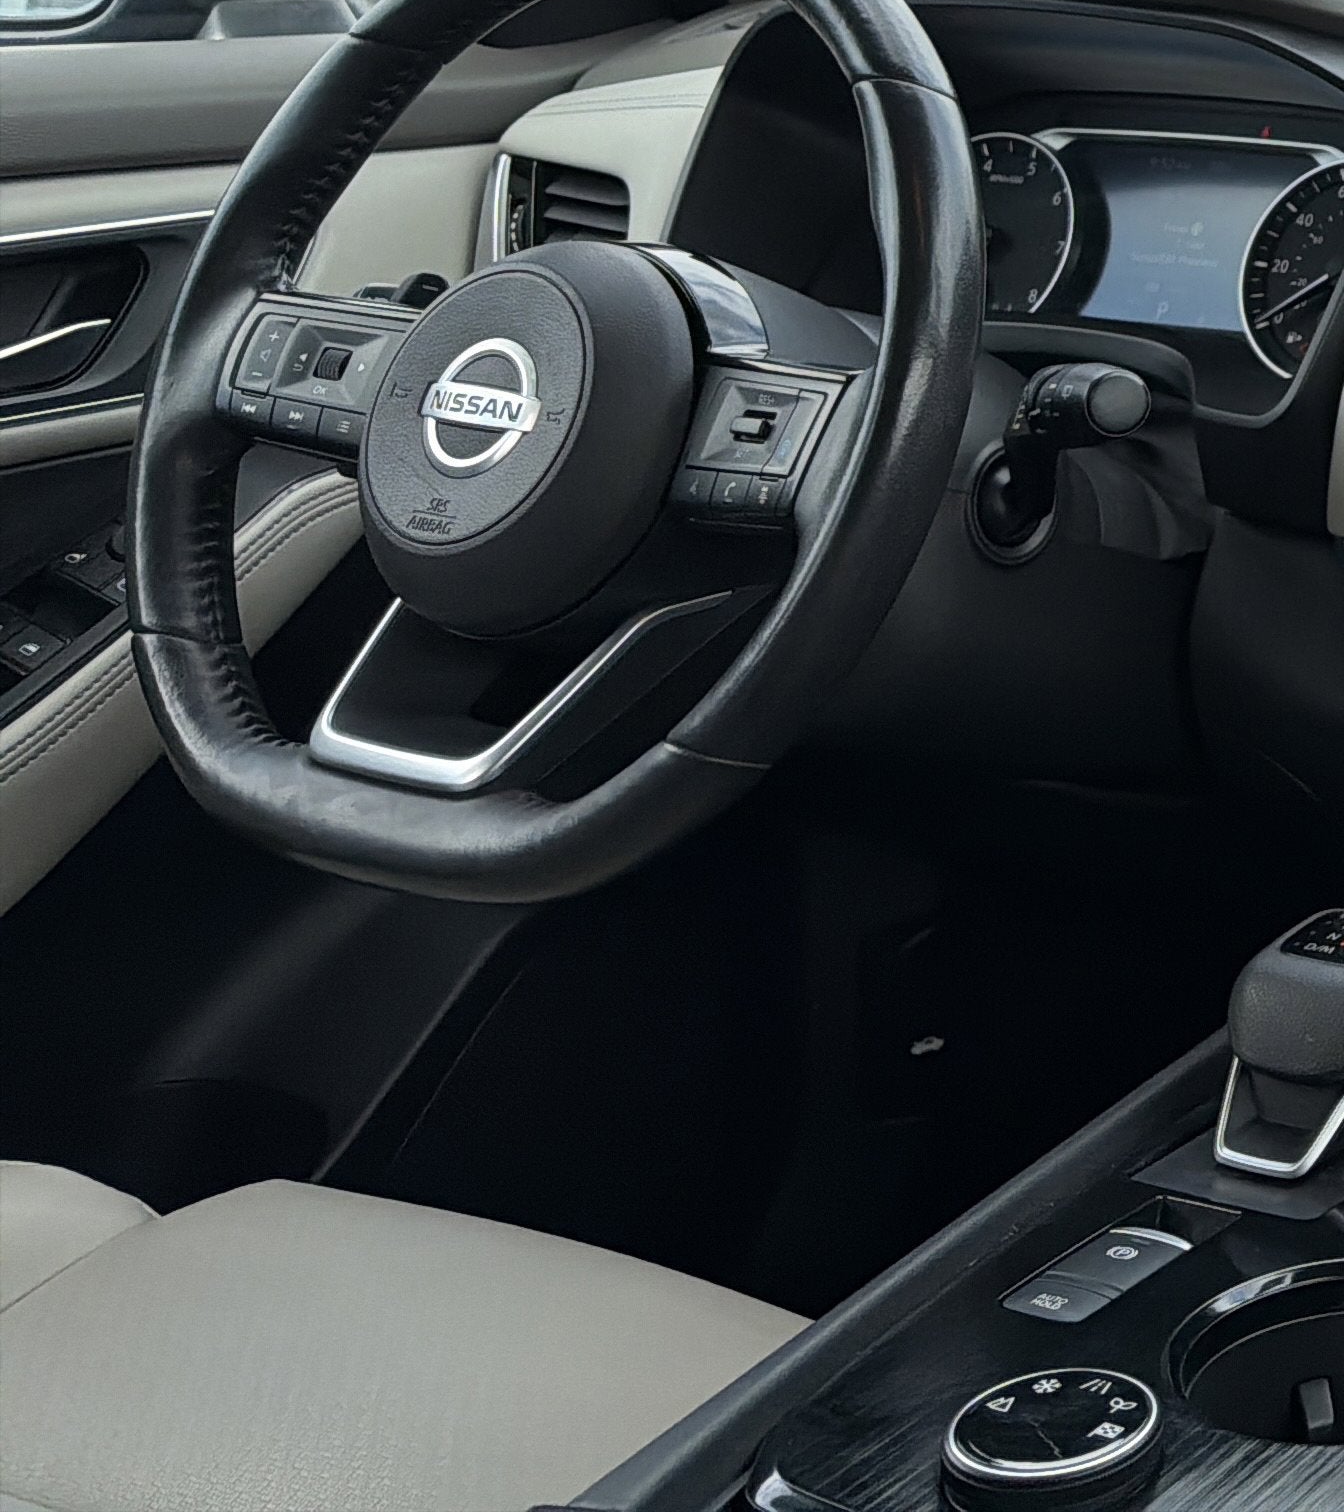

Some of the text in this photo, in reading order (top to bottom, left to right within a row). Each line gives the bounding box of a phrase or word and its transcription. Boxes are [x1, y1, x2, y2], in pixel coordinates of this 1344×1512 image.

[983, 158, 994, 173] 4
[1026, 161, 1038, 176] 5
[1052, 192, 1063, 207] 6
[1296, 213, 1315, 228] 40
[1271, 259, 1290, 274] 20
[1027, 288, 1038, 304] 8
[312, 385, 329, 396] OK
[429, 389, 524, 423] NISSAN
[405, 515, 456, 535] AIRBAG
[1326, 931, 1342, 941] N
[1303, 942, 1336, 955] D/M
[1029, 1298, 1062, 1311] HOLD
[1036, 1292, 1069, 1306] AUTO
